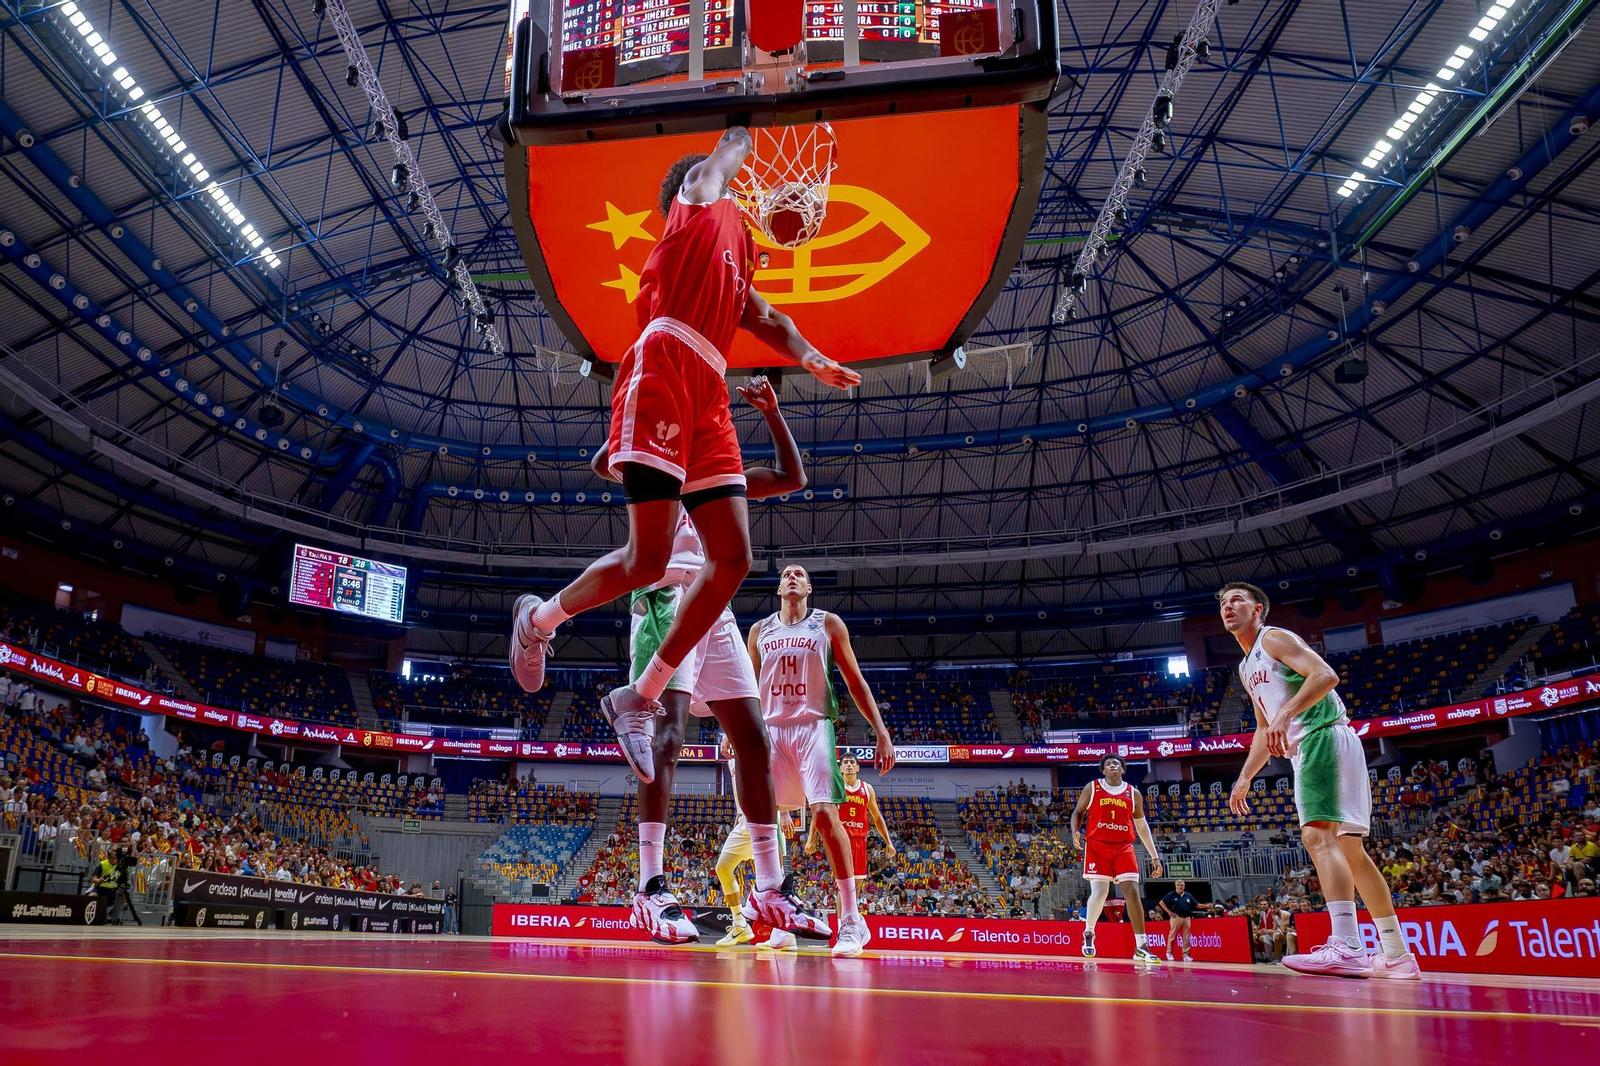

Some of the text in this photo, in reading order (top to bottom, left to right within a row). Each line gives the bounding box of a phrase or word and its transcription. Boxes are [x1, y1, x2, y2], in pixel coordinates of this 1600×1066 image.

[642, 0, 669, 10] MILLER
[642, 8, 675, 22] JIMÉNEZ
[659, 18, 690, 29] GRAHAM
[338, 556, 348, 564] 18
[342, 578, 360, 589] 8:46
[764, 637, 817, 653] PORTUGAL
[781, 656, 797, 674] 14
[115, 687, 141, 700] IBERIA
[771, 682, 806, 696] una
[159, 699, 196, 712] azulmarino
[1382, 713, 1435, 727] azulmarino
[1199, 739, 1244, 751] Andalucía
[856, 748, 874, 759] 28
[1100, 798, 1127, 809] ESPAÑA
[850, 807, 856, 816] 5
[1111, 810, 1115, 819] 1
[1097, 822, 1128, 832] endesa
[209, 883, 238, 896] endesa
[12, 904, 72, 917] #LaFamilia
[511, 914, 630, 929] IBERIA Talento
[879, 927, 1070, 945] IBERIA Talento a bordo
